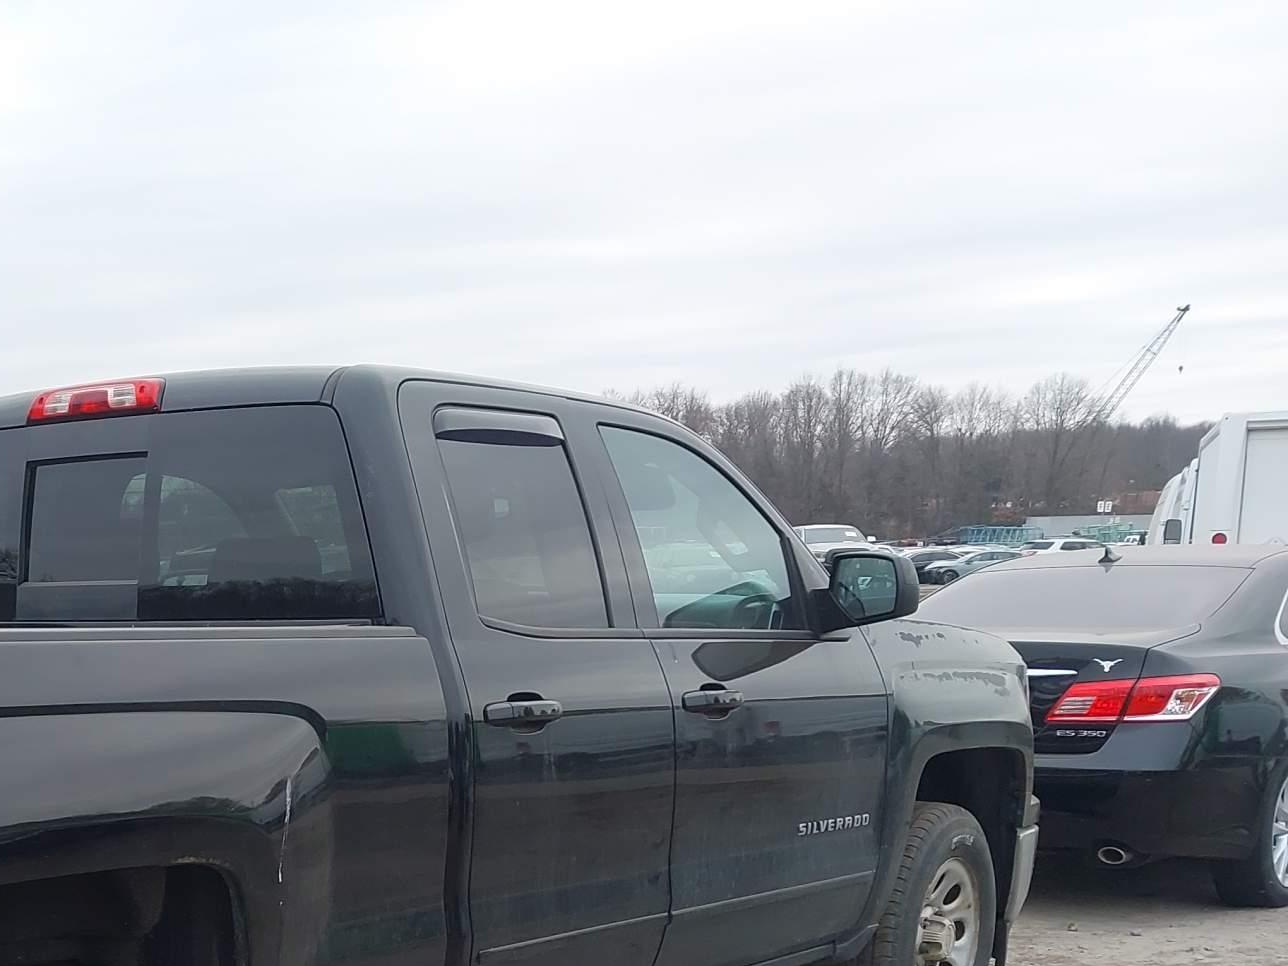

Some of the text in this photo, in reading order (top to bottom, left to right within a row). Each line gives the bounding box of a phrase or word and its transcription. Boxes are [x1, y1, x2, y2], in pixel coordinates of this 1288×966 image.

[1056, 729, 1107, 738] ES 350
[797, 813, 871, 836] SILVERADO
